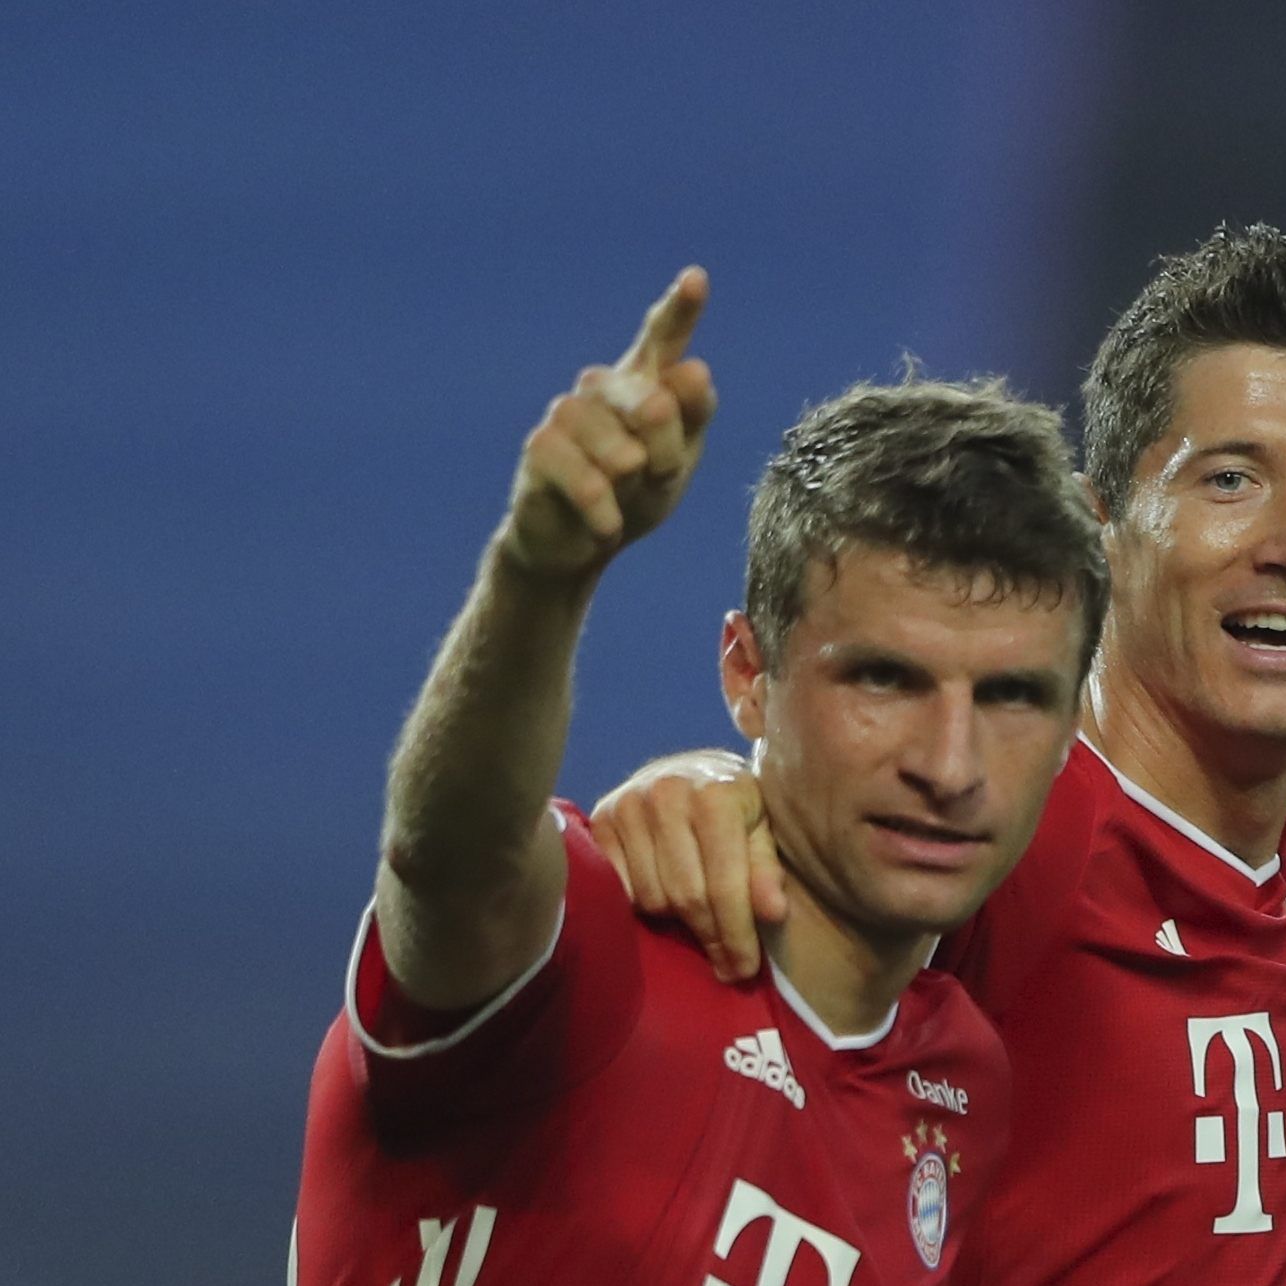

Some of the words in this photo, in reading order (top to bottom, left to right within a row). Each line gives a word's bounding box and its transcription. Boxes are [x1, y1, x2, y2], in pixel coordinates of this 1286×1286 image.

[724, 1046, 806, 1111] adidas
[908, 1070, 968, 1115] Danke
[1187, 1012, 1283, 1235] T
